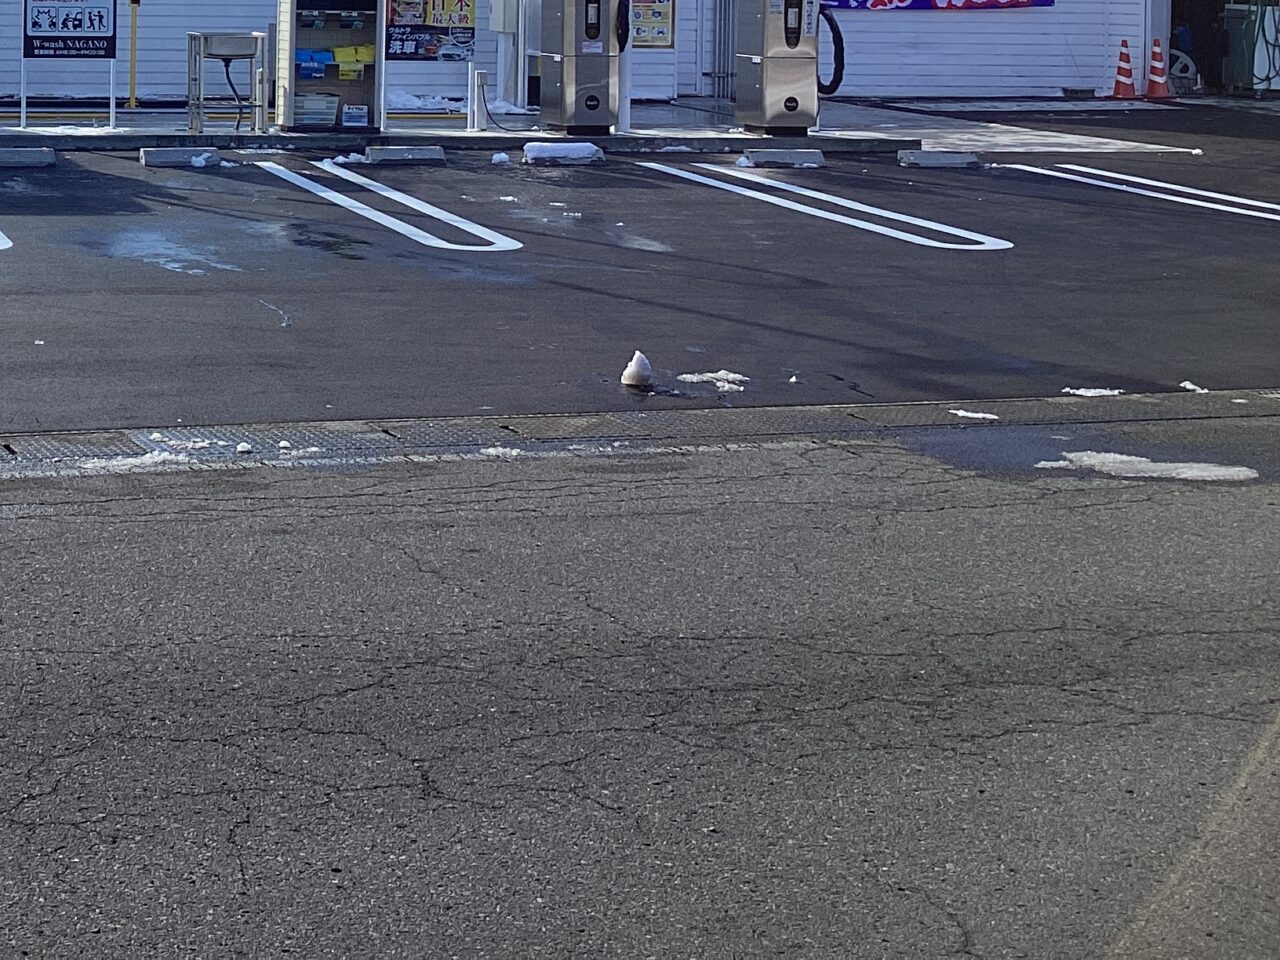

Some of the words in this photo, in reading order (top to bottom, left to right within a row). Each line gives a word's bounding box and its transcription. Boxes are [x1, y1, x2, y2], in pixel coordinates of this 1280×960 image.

[432, 12, 469, 24] 最大級
[33, 40, 64, 48] W-wash
[67, 40, 107, 48] NAGANO
[389, 40, 416, 53] 洗車
